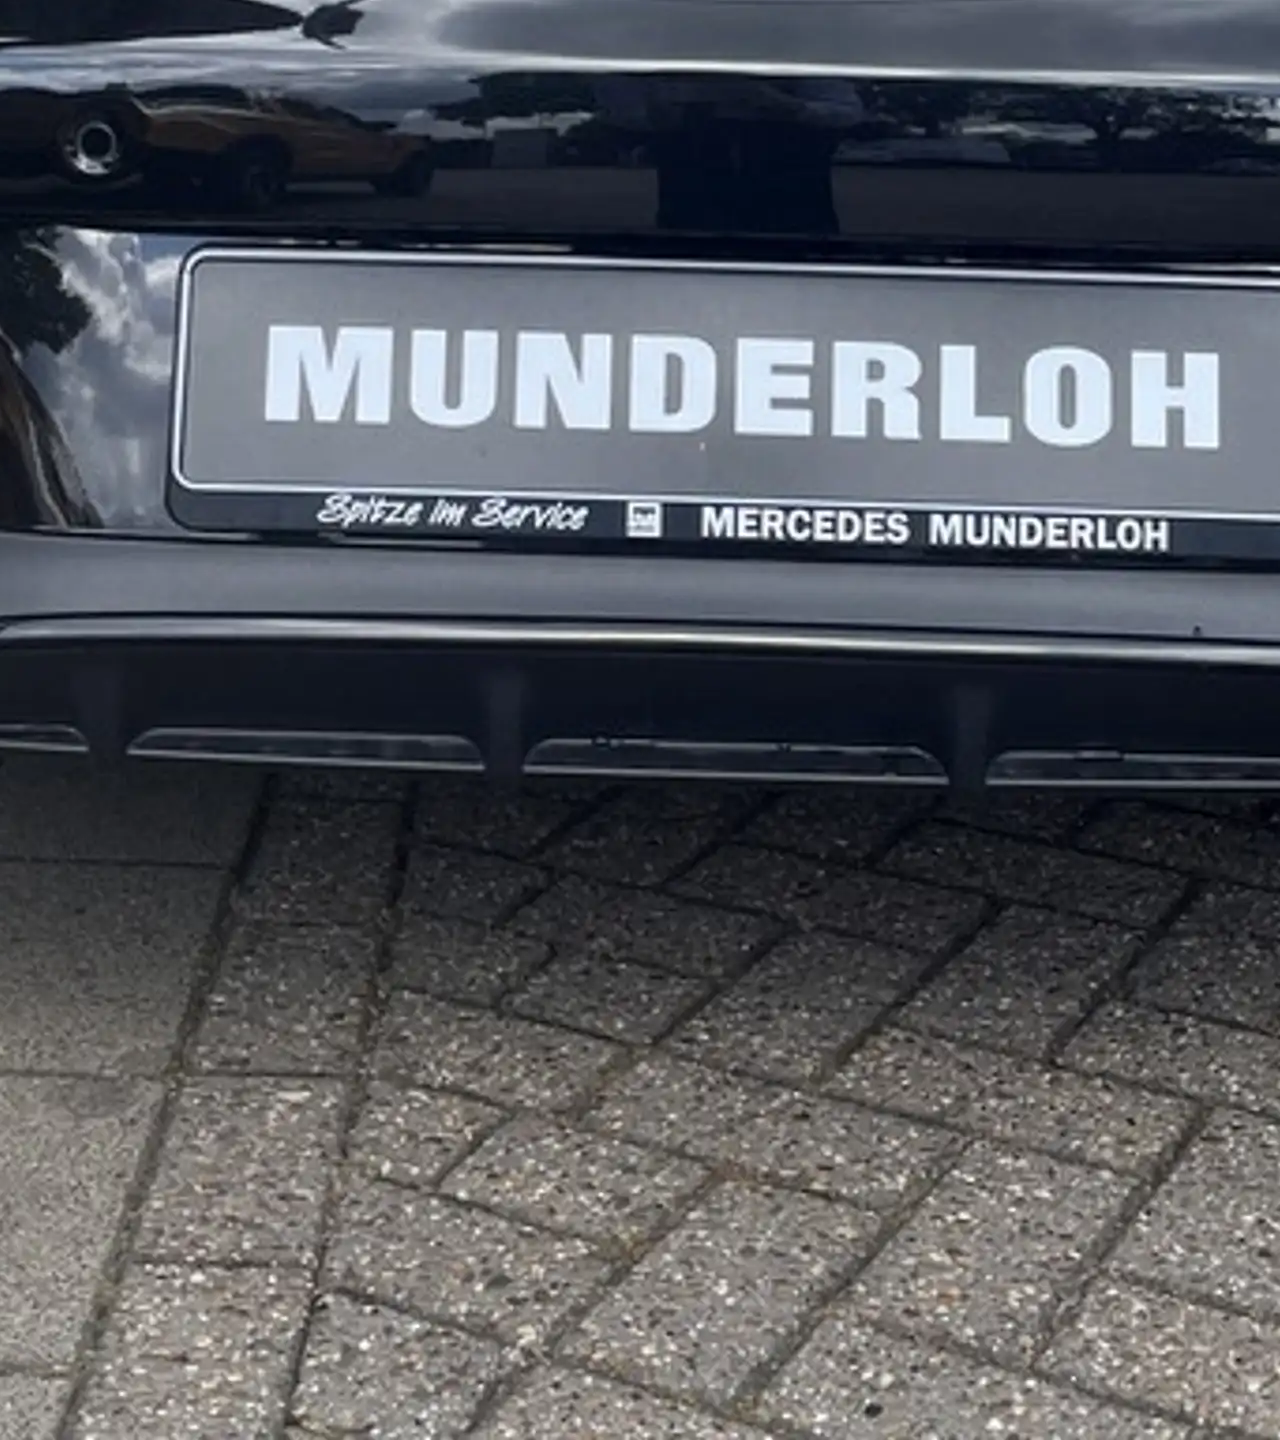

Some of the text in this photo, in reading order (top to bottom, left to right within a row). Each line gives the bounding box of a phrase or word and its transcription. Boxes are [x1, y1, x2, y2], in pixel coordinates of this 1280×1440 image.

[262, 322, 1223, 452] MUNDERLOH
[316, 493, 424, 529] Spitze
[428, 497, 468, 527] im
[471, 498, 590, 531] Service
[700, 505, 911, 545] MERCEDES
[928, 512, 1171, 553] MUNDERLOH
